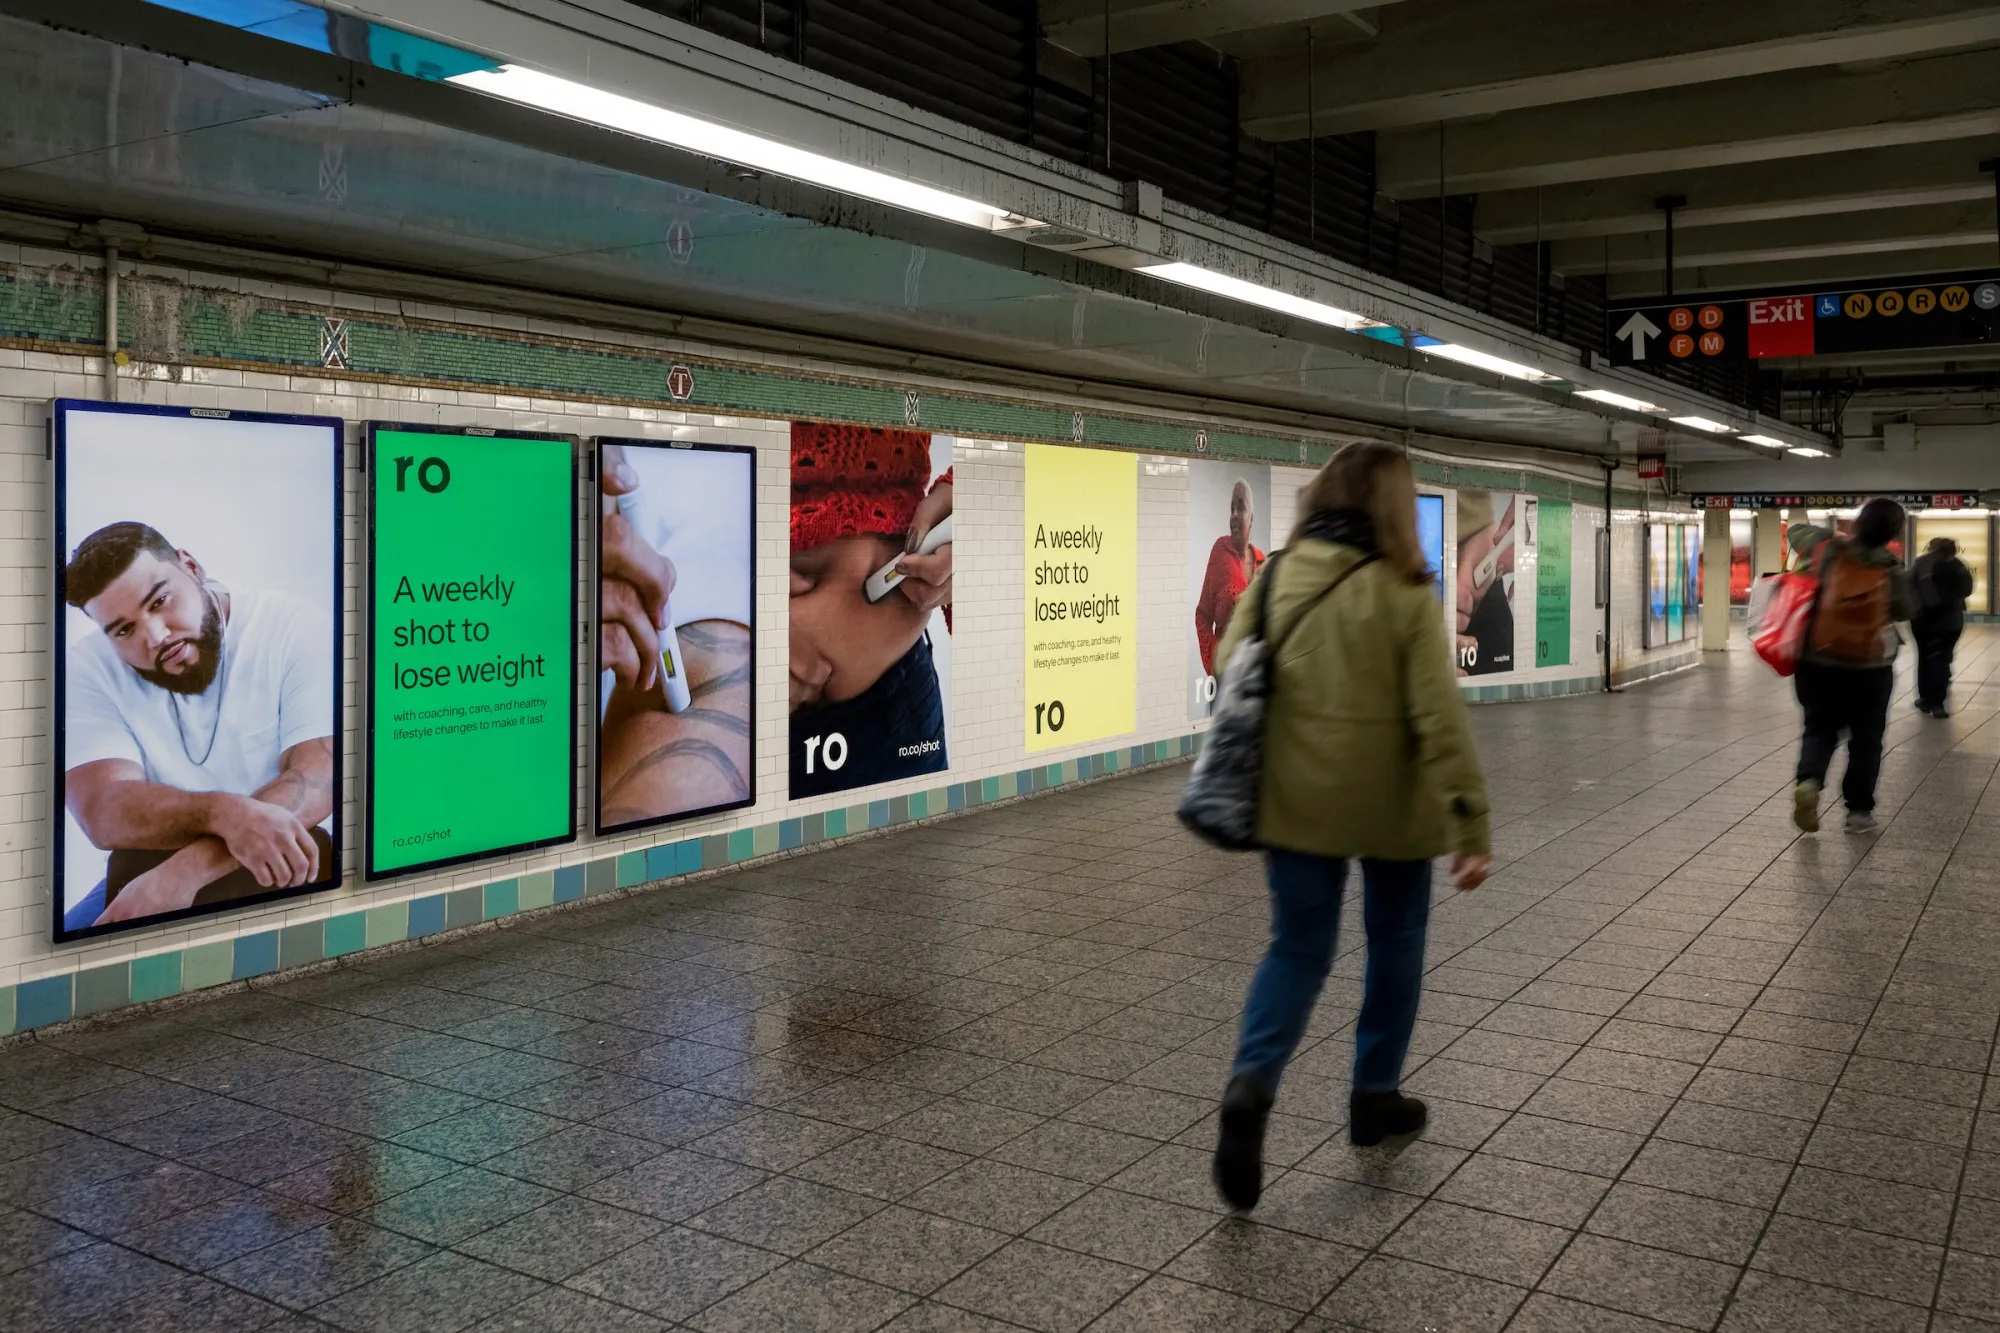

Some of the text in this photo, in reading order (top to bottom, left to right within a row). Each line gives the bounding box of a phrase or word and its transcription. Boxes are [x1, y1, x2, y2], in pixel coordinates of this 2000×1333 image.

[1750, 299, 1805, 324] Exit
[393, 456, 451, 494] ro
[1705, 496, 1729, 508] Exit
[1932, 496, 1959, 507] Exit
[1034, 524, 1103, 555] A weekly
[1034, 560, 1089, 585] shot to
[393, 574, 515, 606] A weekly
[1035, 593, 1120, 624] lose weight
[393, 618, 490, 647] shot to
[1033, 641, 1047, 651] with
[1047, 640, 1077, 651] coaching,
[1090, 636, 1102, 646] and
[1101, 635, 1121, 645] healthy
[1033, 658, 1056, 669] lifestyle
[1056, 655, 1082, 667] changes
[1082, 655, 1089, 663] to
[1089, 653, 1105, 662] make
[1461, 646, 1477, 667] ro
[394, 653, 545, 690] lose weight
[1195, 675, 1218, 704] ro
[393, 697, 548, 723] with coaching, care, and healthy
[1034, 700, 1065, 734] ro
[393, 727, 433, 740] lifestyle
[434, 722, 478, 735] changes
[479, 720, 490, 730] to
[491, 717, 518, 729] make
[519, 716, 526, 725] it
[803, 732, 848, 774] ro
[898, 740, 940, 757] ro.co/shot
[392, 828, 452, 848] ro.co/shot
